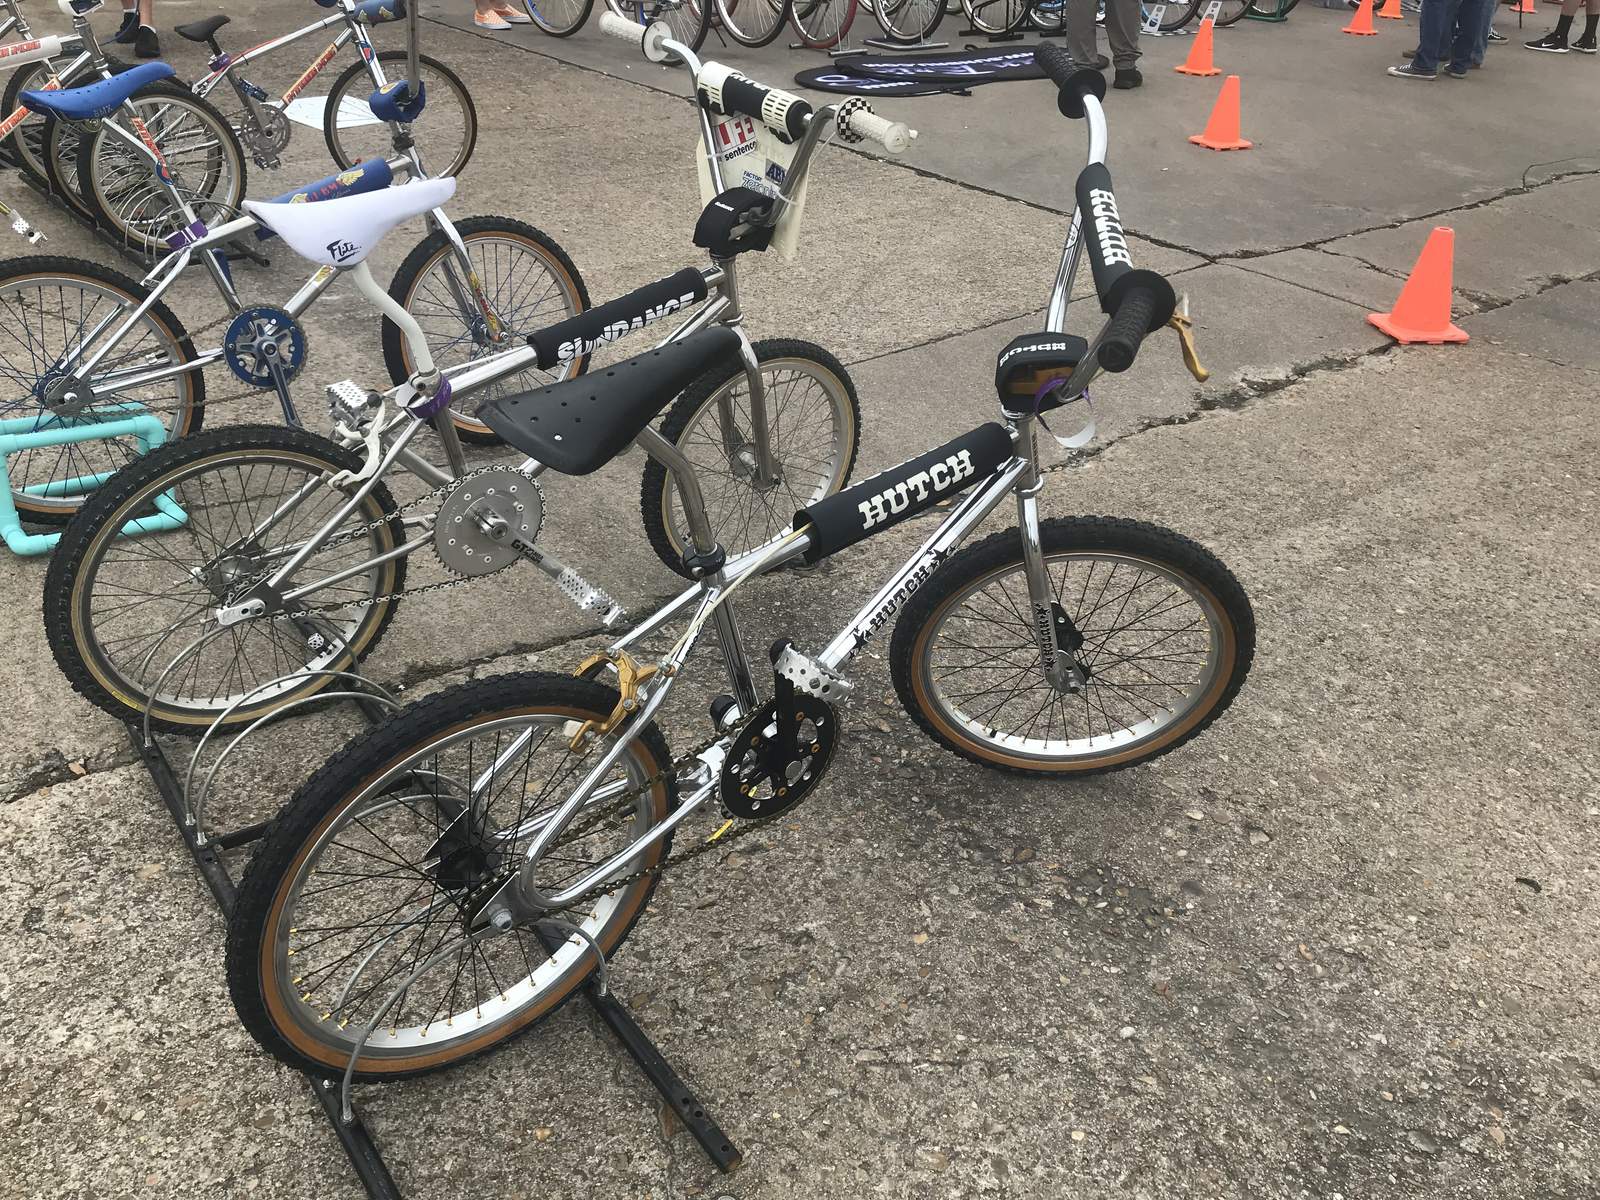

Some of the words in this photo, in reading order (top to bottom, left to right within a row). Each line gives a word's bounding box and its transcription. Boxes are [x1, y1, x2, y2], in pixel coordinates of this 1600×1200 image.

[326, 239, 360, 261] Flite
[1090, 188, 1134, 269] HUTCH
[858, 449, 975, 530] HUTCH
[510, 538, 530, 555] GT
[869, 565, 930, 632] HUTCH
